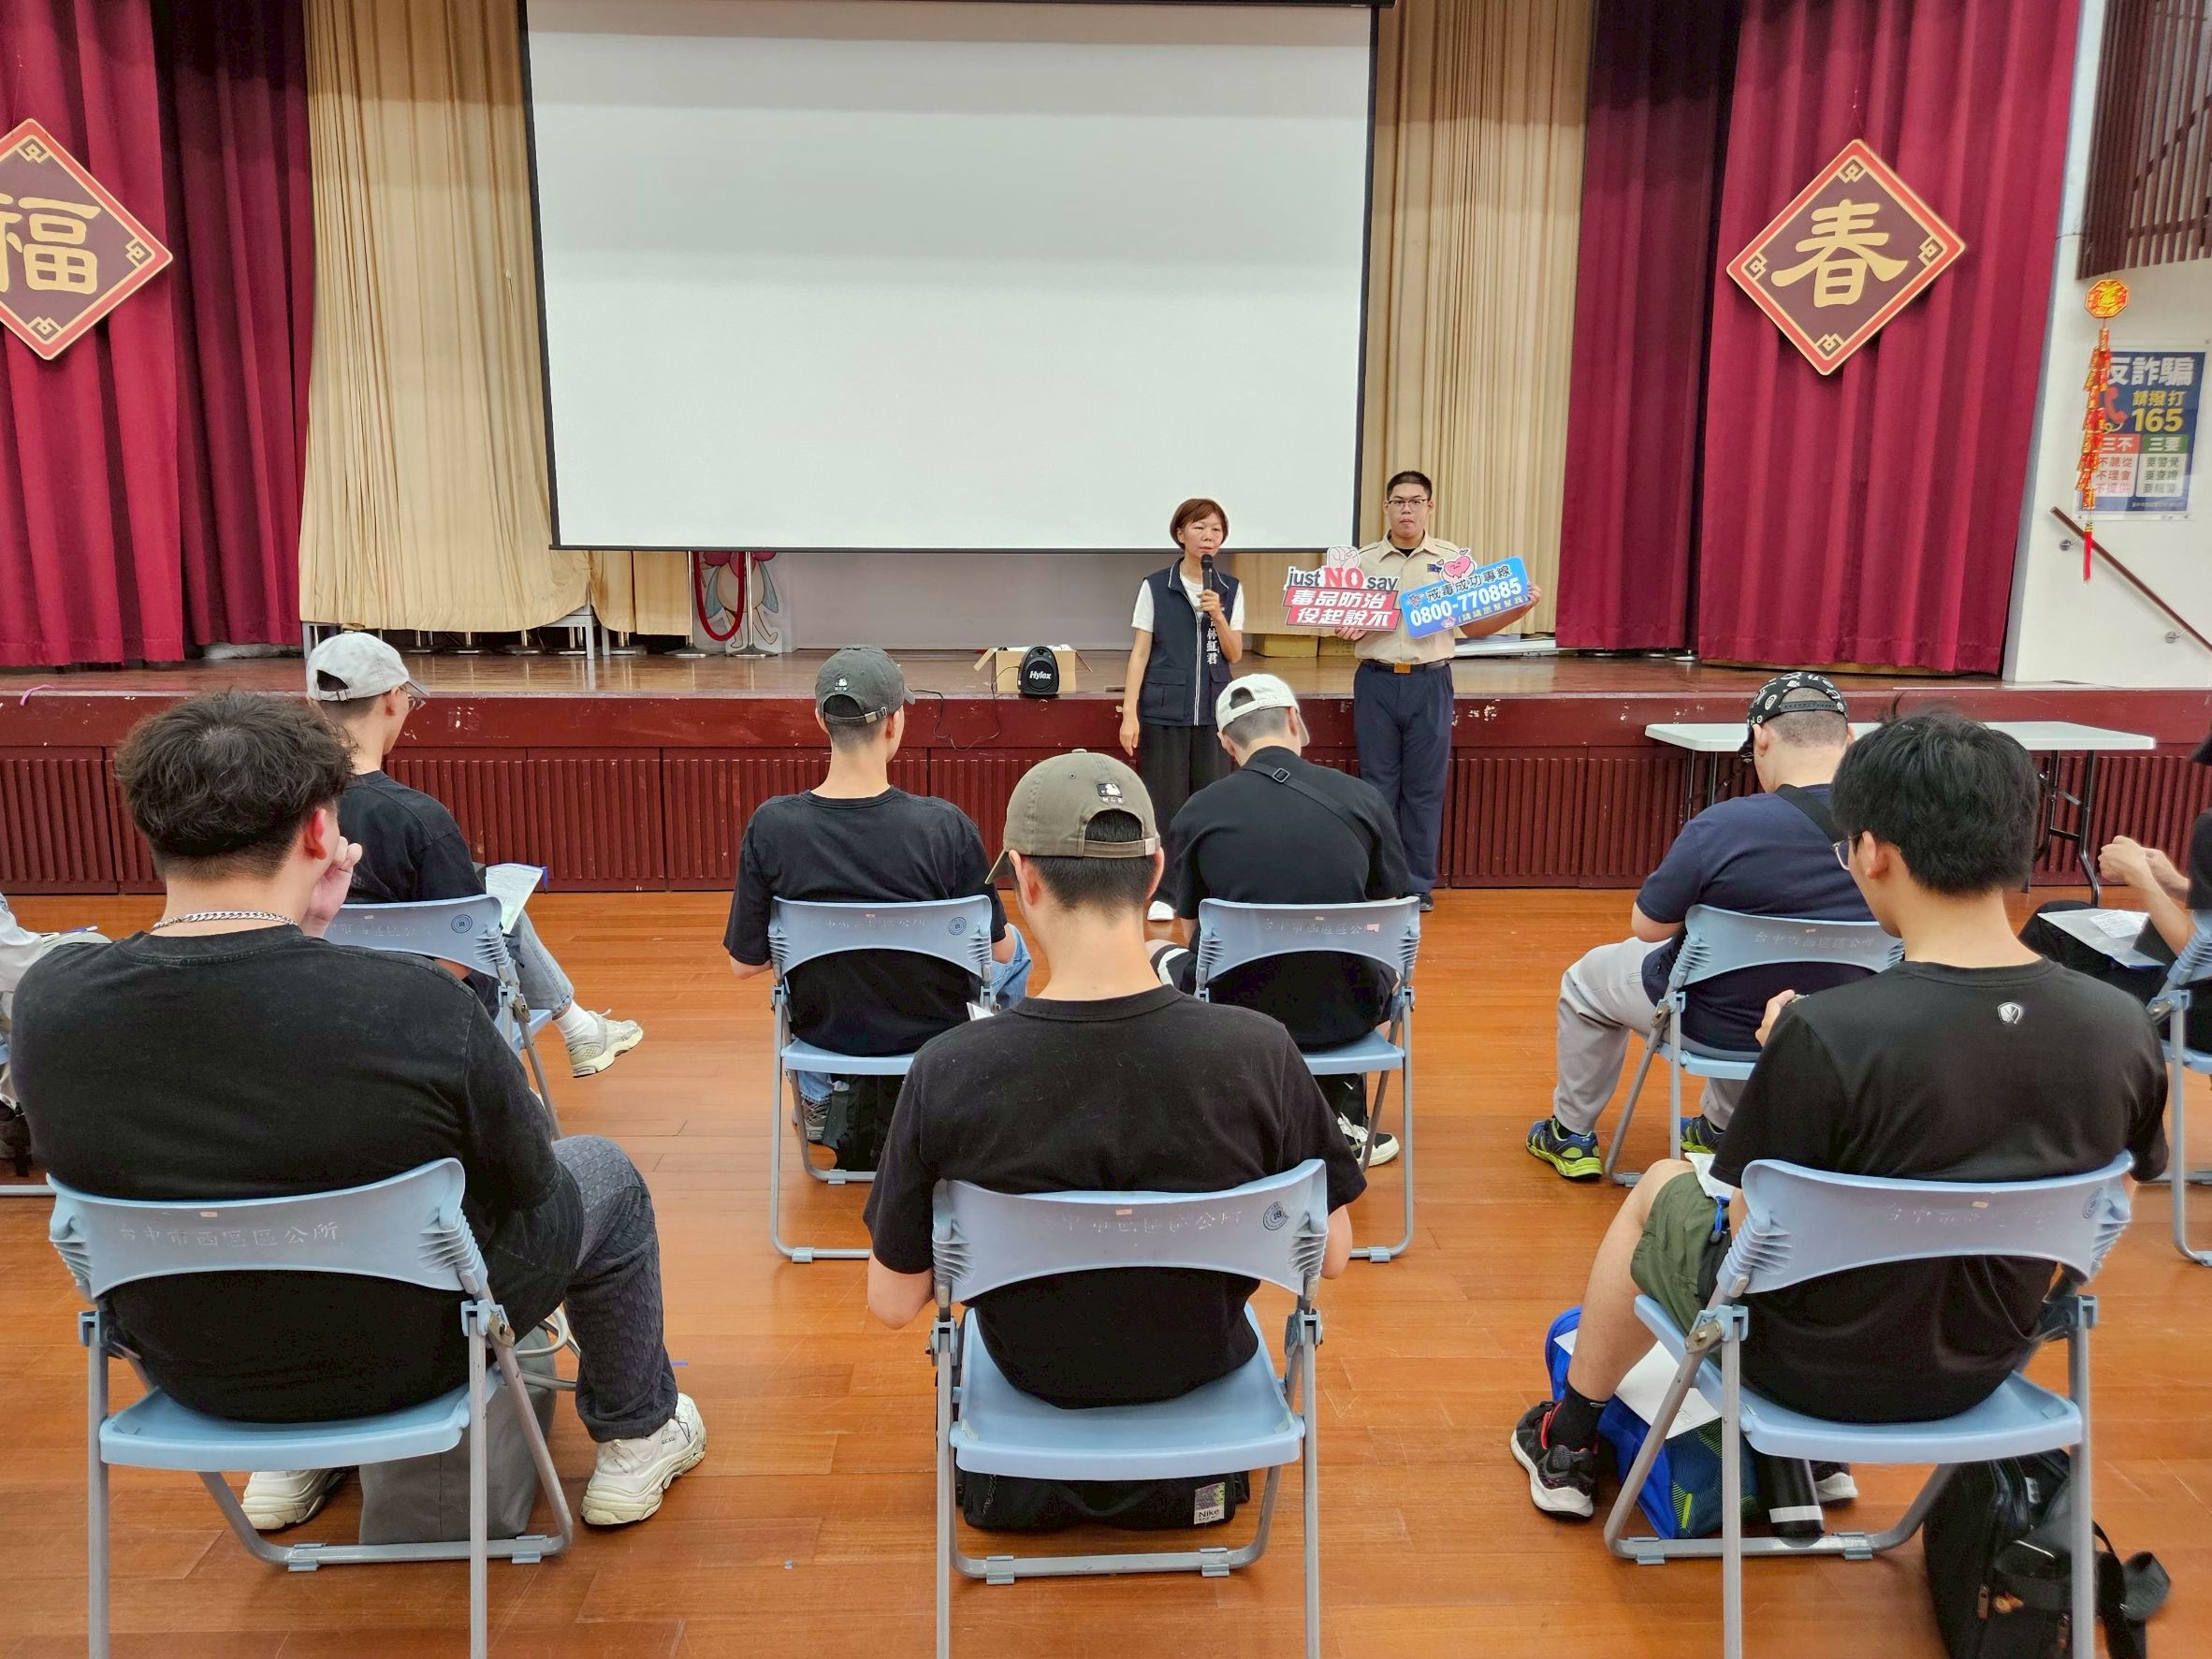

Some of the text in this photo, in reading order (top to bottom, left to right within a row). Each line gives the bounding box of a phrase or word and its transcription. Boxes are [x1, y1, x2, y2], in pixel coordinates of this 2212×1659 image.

[0, 193, 101, 295] 福
[1771, 199, 1909, 308] 春
[2107, 357, 2195, 386] 反詐騙
[2132, 390, 2187, 406] 請撥打
[2132, 408, 2184, 432] 165
[2101, 436, 2133, 452] 三不
[2148, 436, 2181, 452] 三要
[1288, 567, 1398, 593] just NO say
[1291, 589, 1386, 609] 毒品防治
[1410, 577, 1521, 627] 0800-770885
[1296, 607, 1392, 626] 役起說不
[1199, 1509, 1219, 1518] Nike
